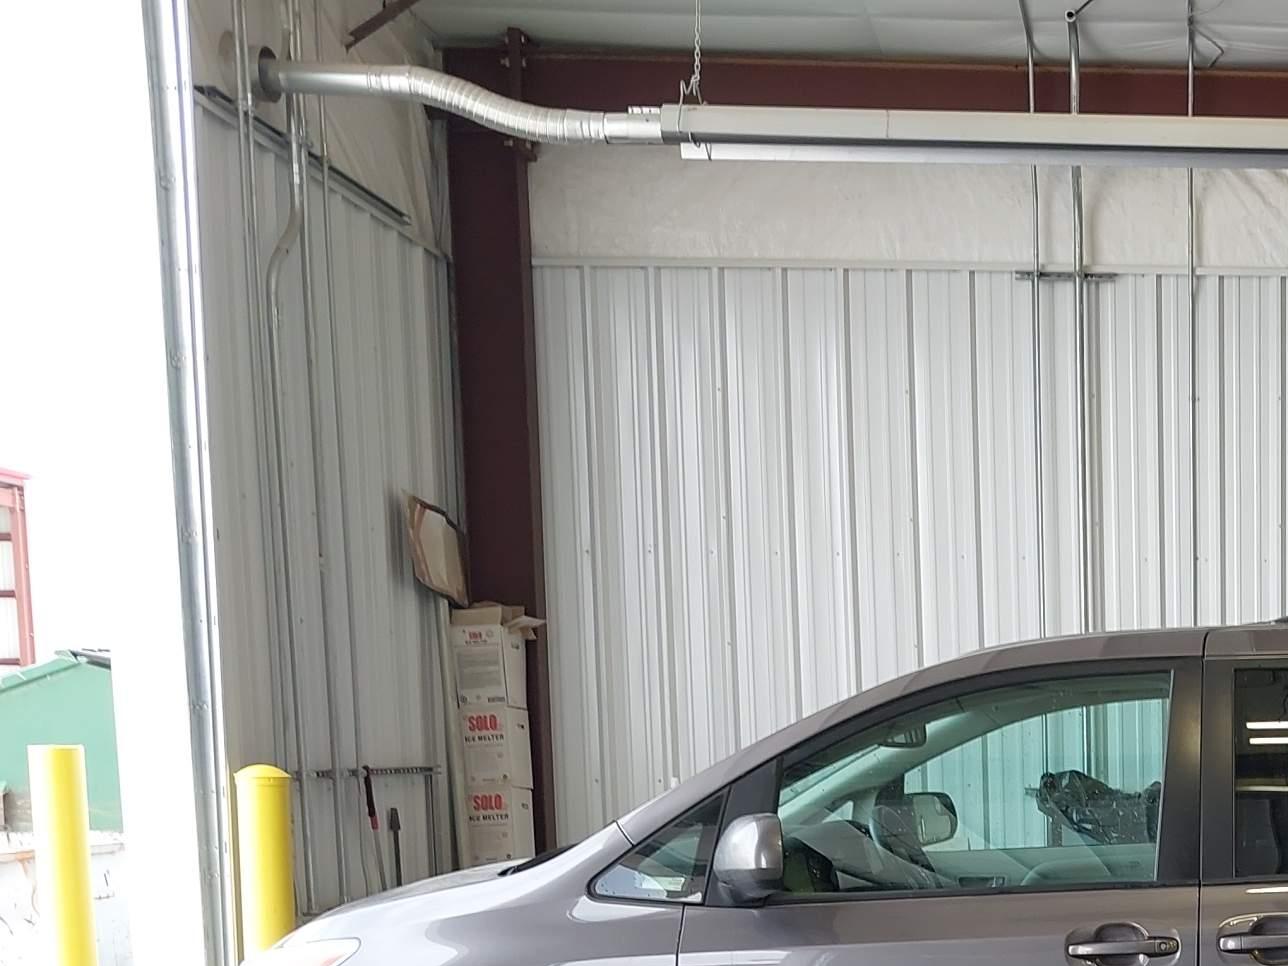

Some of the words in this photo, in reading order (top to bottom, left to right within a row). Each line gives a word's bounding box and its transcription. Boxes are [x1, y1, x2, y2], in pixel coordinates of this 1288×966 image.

[468, 714, 497, 731] SOLO
[477, 734, 504, 742] MELTER
[473, 794, 503, 811] SOLO
[482, 813, 509, 821] MELTER
